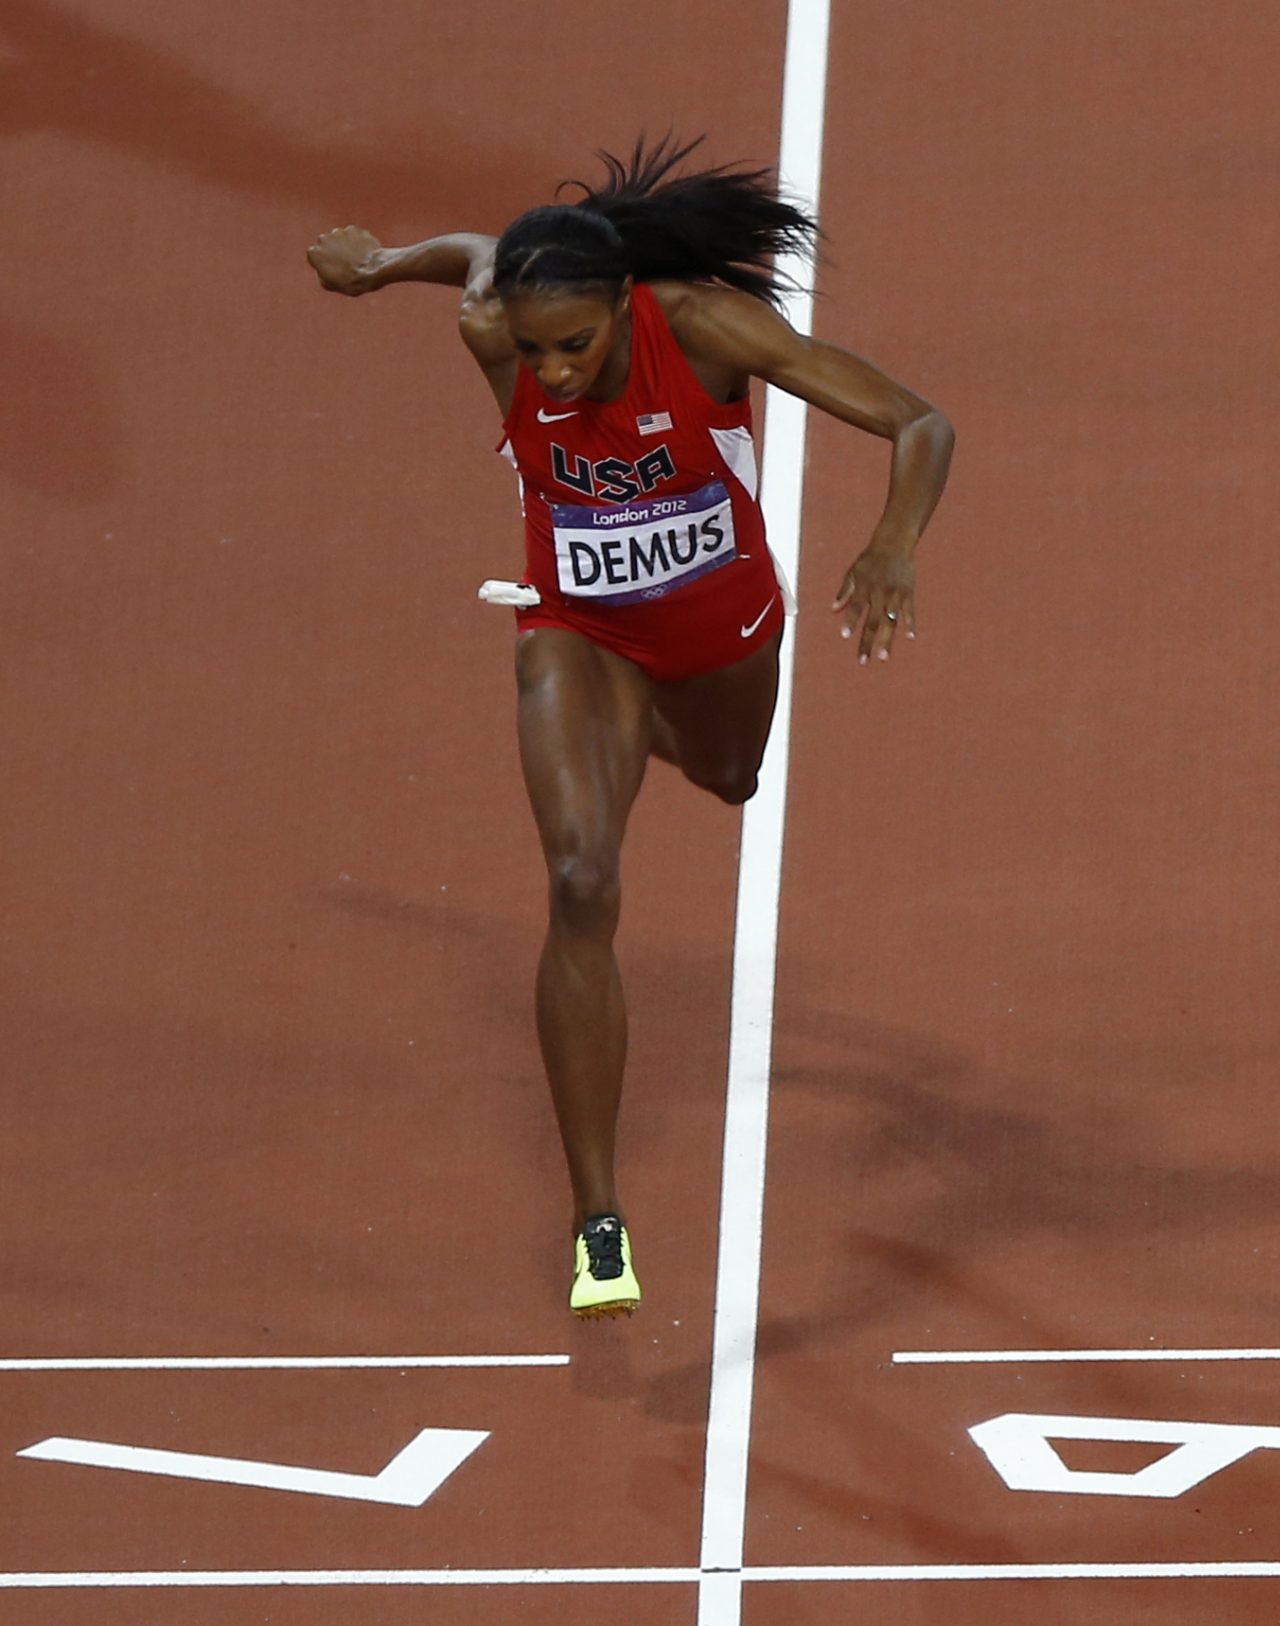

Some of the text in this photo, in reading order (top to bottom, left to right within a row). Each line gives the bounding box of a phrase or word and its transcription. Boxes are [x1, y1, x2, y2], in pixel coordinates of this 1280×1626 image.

[550, 441, 677, 505] USA
[592, 500, 687, 526] London 2012
[568, 514, 724, 586] DEMUS
[16, 1427, 491, 1507] 7
